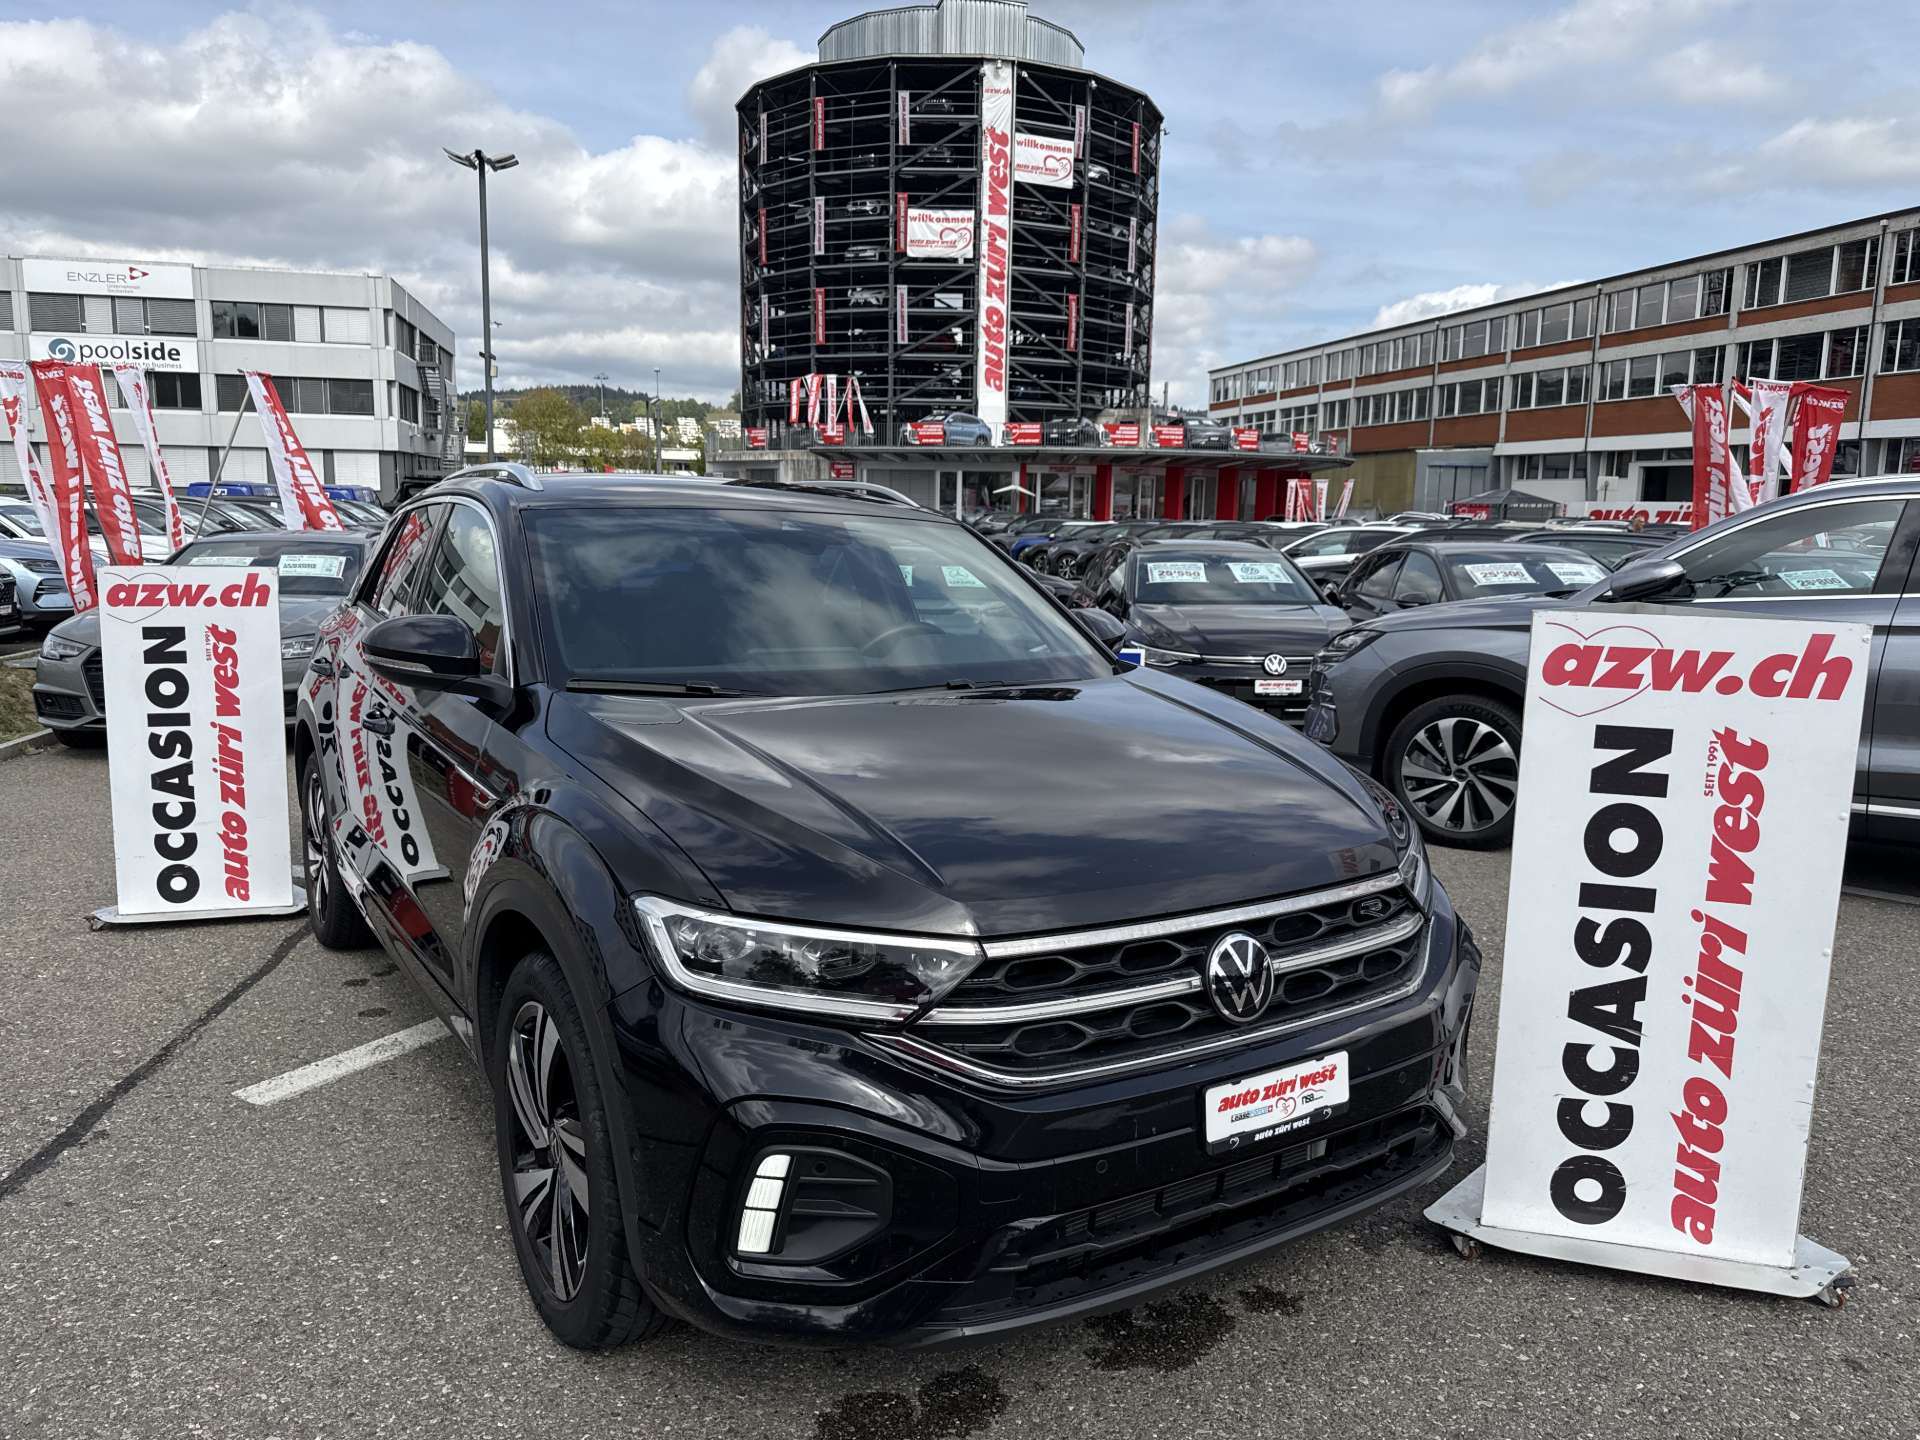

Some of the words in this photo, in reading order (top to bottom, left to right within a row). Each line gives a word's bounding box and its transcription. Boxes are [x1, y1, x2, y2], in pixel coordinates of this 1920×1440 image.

[985, 125, 1010, 216] west
[1016, 138, 1073, 154] willkommen
[909, 213, 973, 224] willkommen
[67, 271, 127, 284] ENZLER
[982, 219, 1008, 305] züri
[79, 340, 181, 361] poolside
[982, 306, 1005, 392] auto
[69, 375, 110, 432] west
[1706, 396, 1726, 464] west
[90, 434, 127, 495] züri
[112, 494, 141, 559] auto
[106, 573, 271, 608] azw.ch
[204, 623, 241, 717] west
[1542, 634, 1853, 701] azw.ch
[142, 626, 200, 904] OCCASION
[209, 721, 246, 809] züri
[1704, 771, 1716, 797] SEIT
[1707, 739, 1719, 768] 1991
[1705, 726, 1770, 906] west
[215, 810, 250, 902] auto
[1550, 724, 1674, 1225] OCCASION
[1681, 907, 1748, 1080] züri
[1218, 1087, 1260, 1112] auto
[1260, 1075, 1298, 1101] züri
[1299, 1065, 1337, 1089] west
[1254, 1129, 1273, 1141] auto
[1274, 1122, 1291, 1135] züri
[1292, 1116, 1311, 1129] west
[1668, 1076, 1729, 1245] auto
